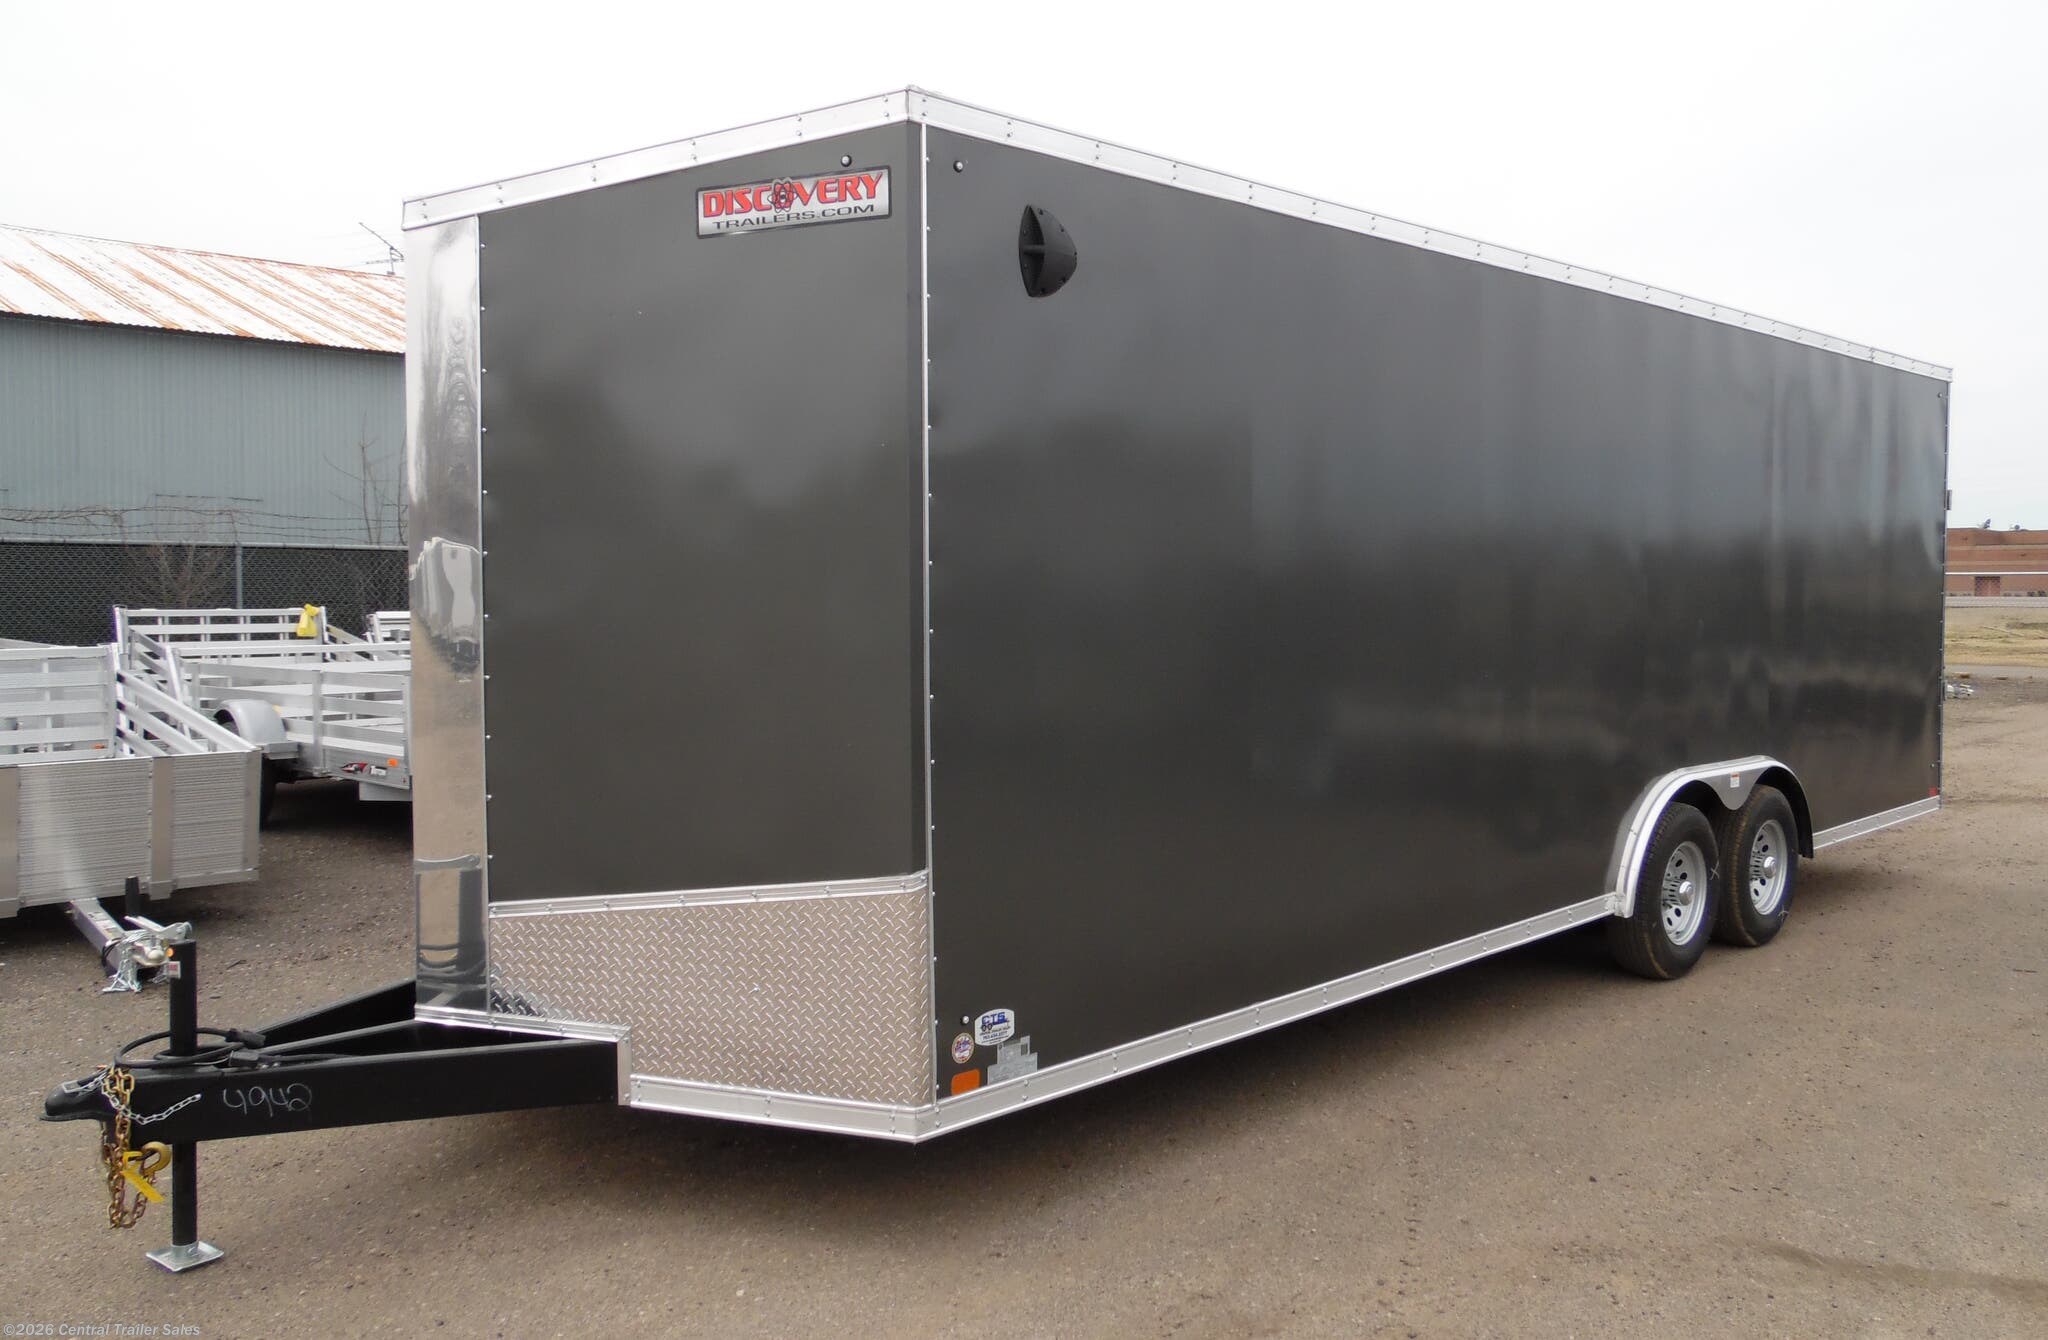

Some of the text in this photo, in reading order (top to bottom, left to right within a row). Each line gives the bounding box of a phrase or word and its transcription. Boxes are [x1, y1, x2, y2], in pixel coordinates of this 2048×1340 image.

[703, 172, 883, 218] DISCOVERY
[712, 204, 874, 230] TRAILERS.COM
[981, 1012, 1006, 1025] CTS
[223, 1083, 312, 1117] 4942
